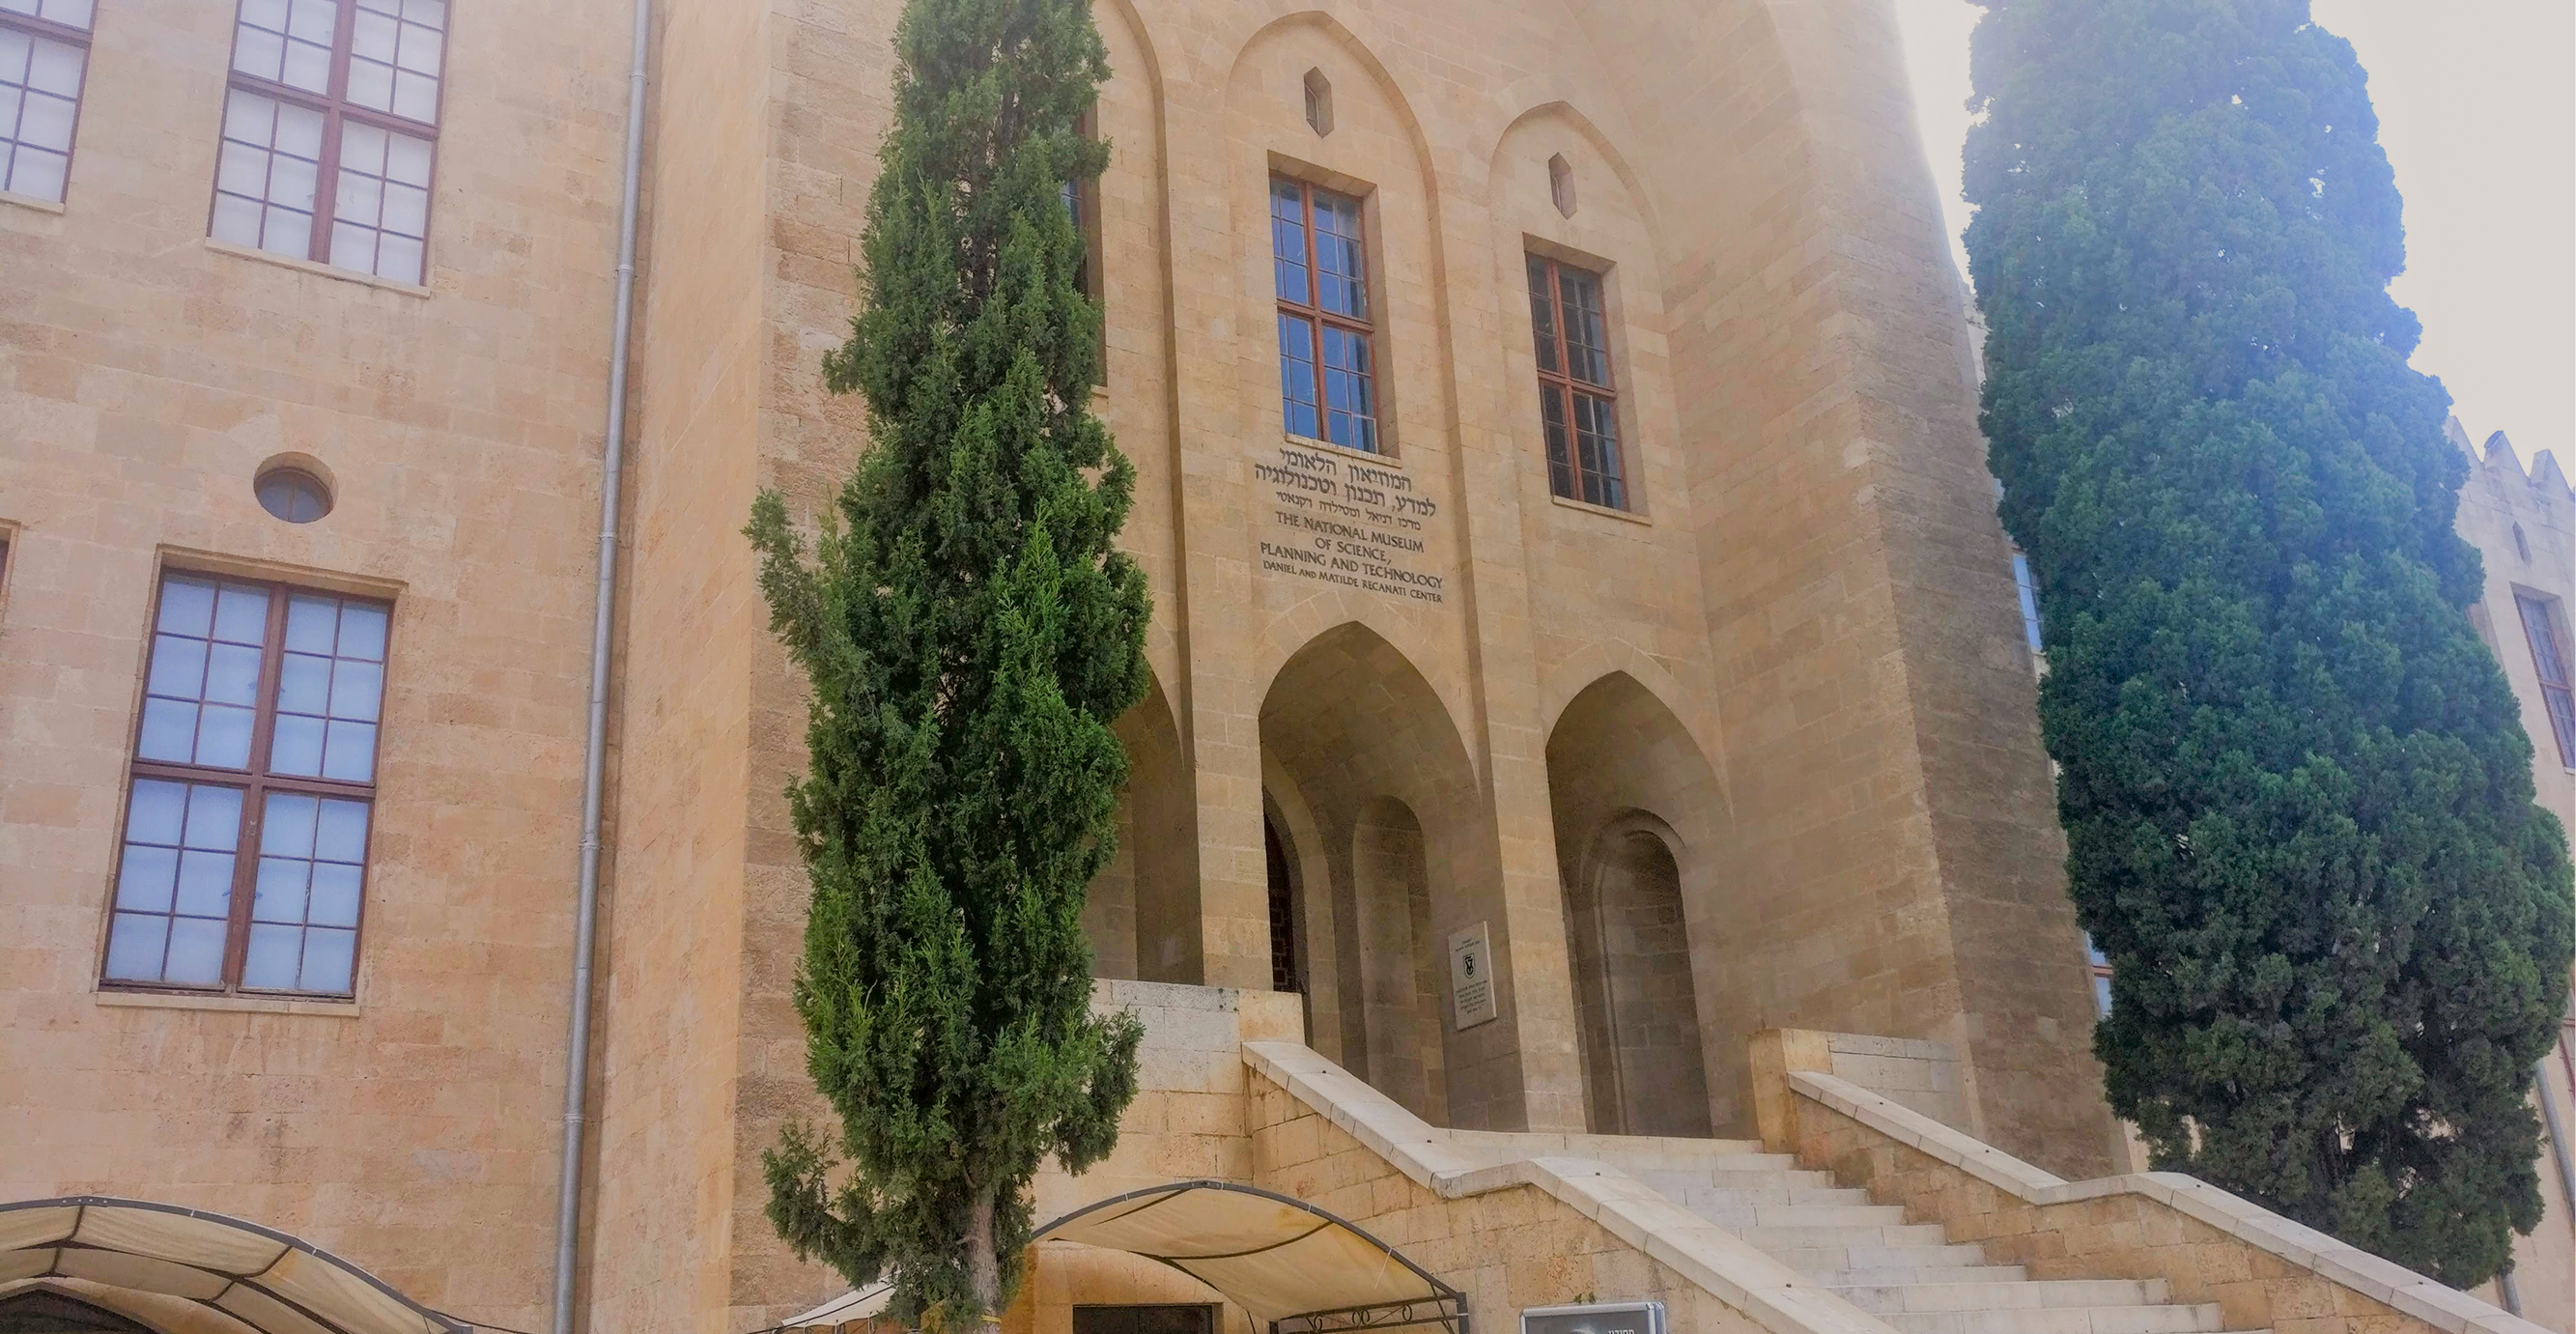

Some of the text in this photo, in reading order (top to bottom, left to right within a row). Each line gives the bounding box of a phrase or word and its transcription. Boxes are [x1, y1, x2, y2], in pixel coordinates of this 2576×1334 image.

[1255, 463, 1436, 517] למדע, תכנון וטכנולוגיה
[1279, 447, 1412, 492] המוזיאון הלאומי
[1276, 491, 1421, 530] מרכז דניאל ומטילדה רקנאטי
[1276, 511, 1425, 553] THE NATIONAL MUSEUM
[1260, 542, 1442, 589] PLANNING AND TECHNOLOGY
[1315, 537, 1392, 565] OF SCIENCE,
[1263, 559, 1443, 604] DANIEL AND MATILDE RECANATI CENTER
